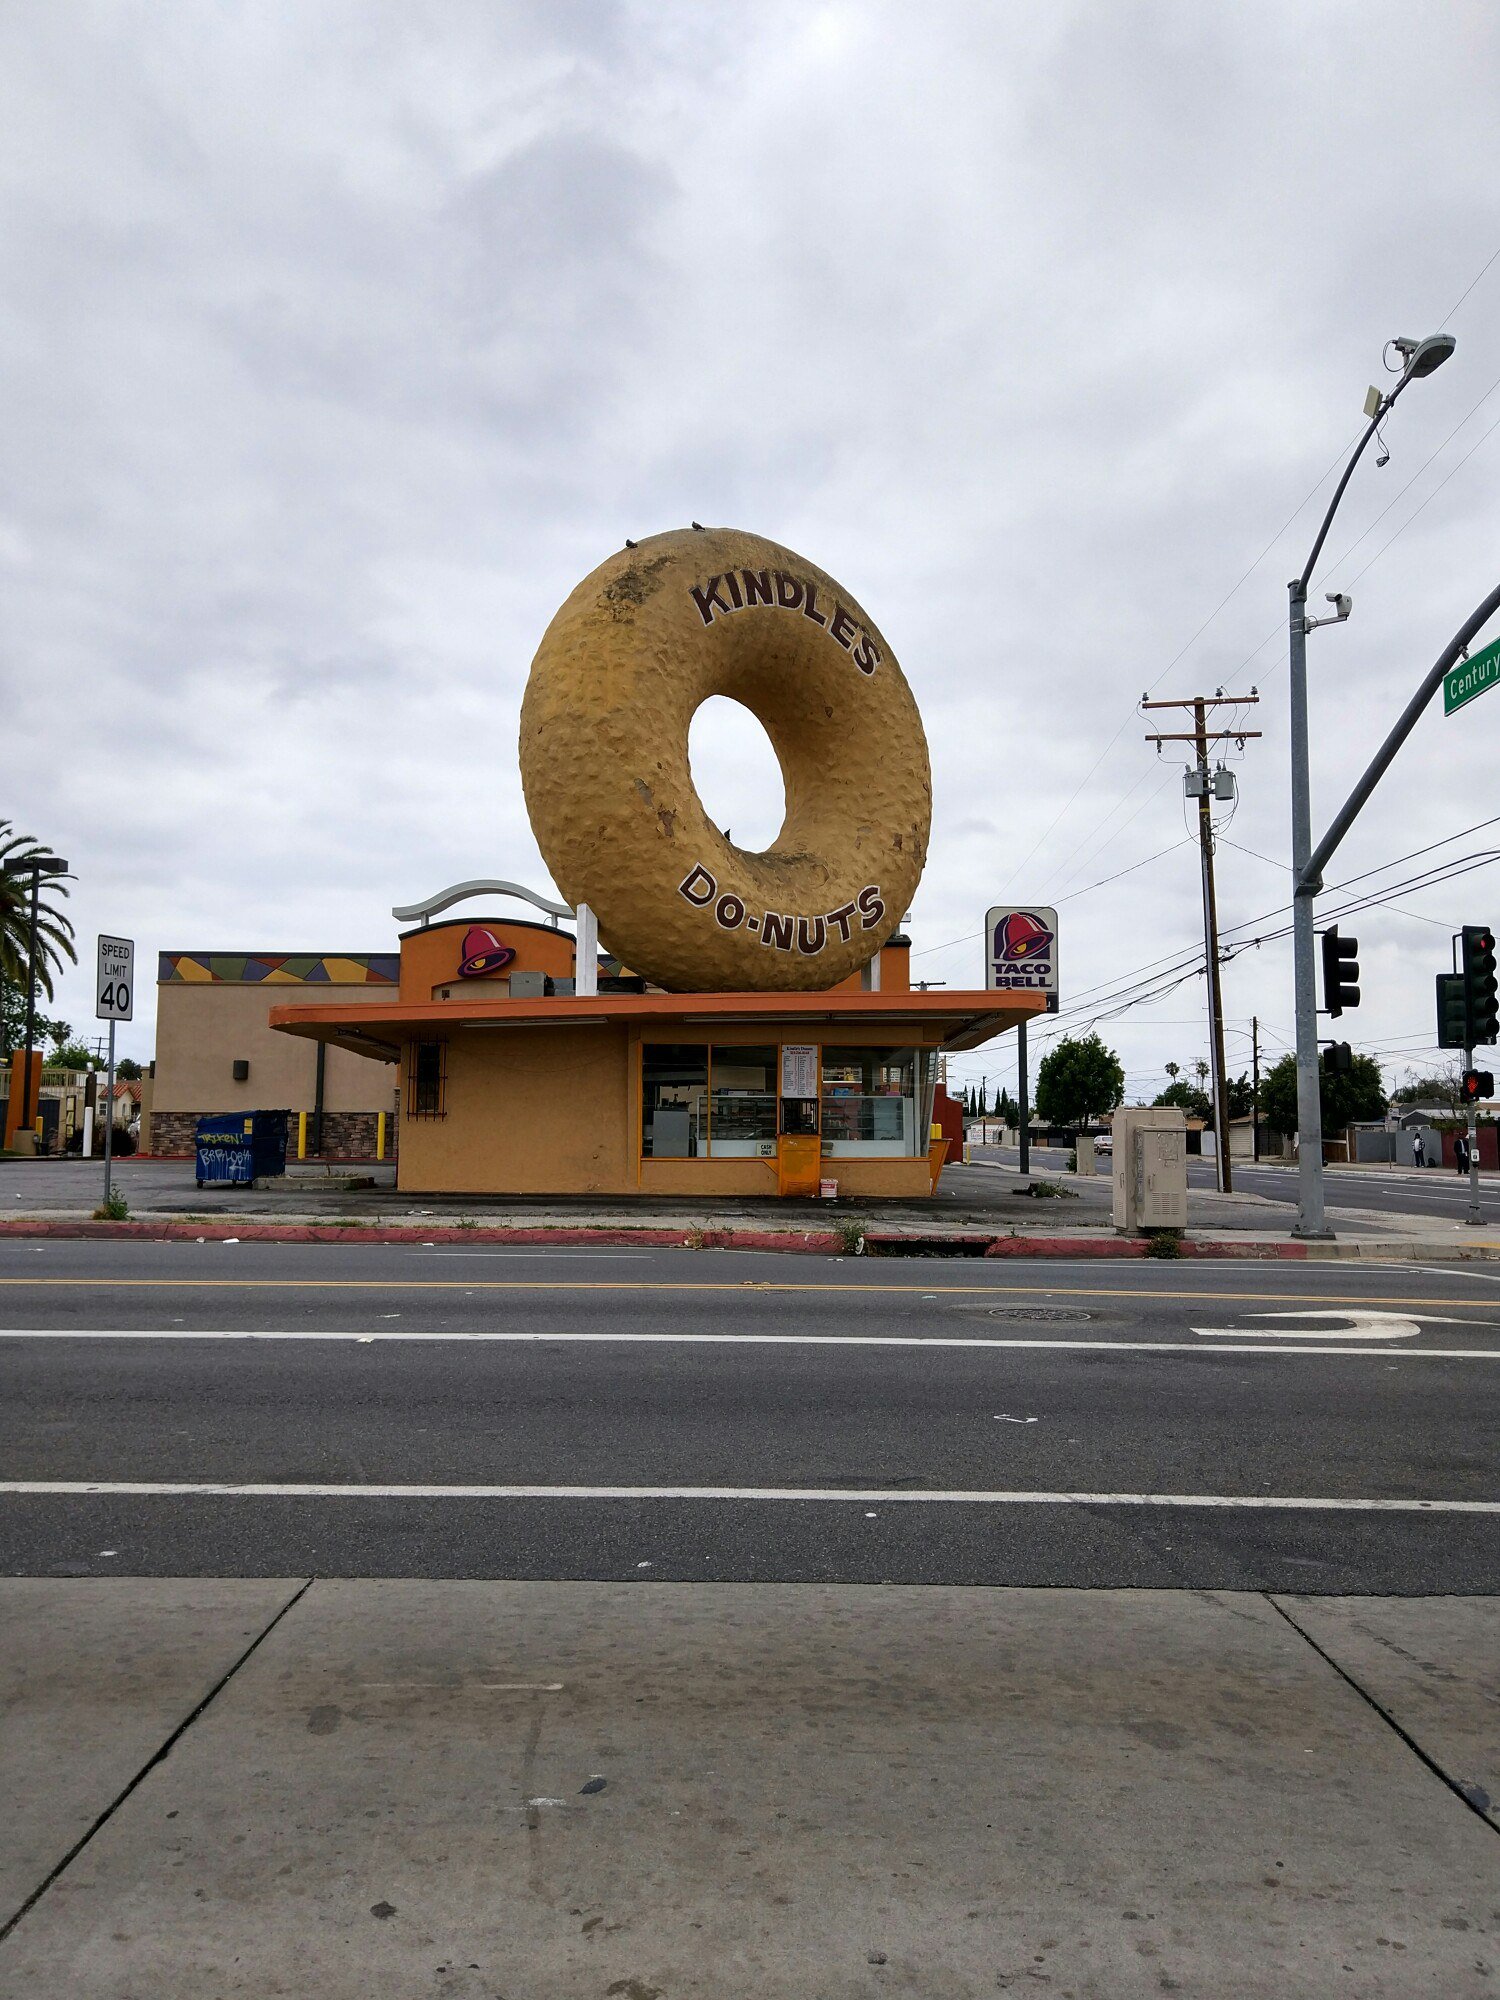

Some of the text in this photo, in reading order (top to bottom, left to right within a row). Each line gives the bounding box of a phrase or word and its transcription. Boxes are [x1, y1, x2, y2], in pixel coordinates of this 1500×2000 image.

[1450, 652, 1500, 700] Century
[677, 862, 885, 955] DO-NUTS
[101, 943, 130, 959] SPEED
[104, 962, 127, 978] LIMIT
[991, 963, 1052, 975] TACO
[995, 976, 1053, 988] BELL
[100, 981, 130, 1012] 40
